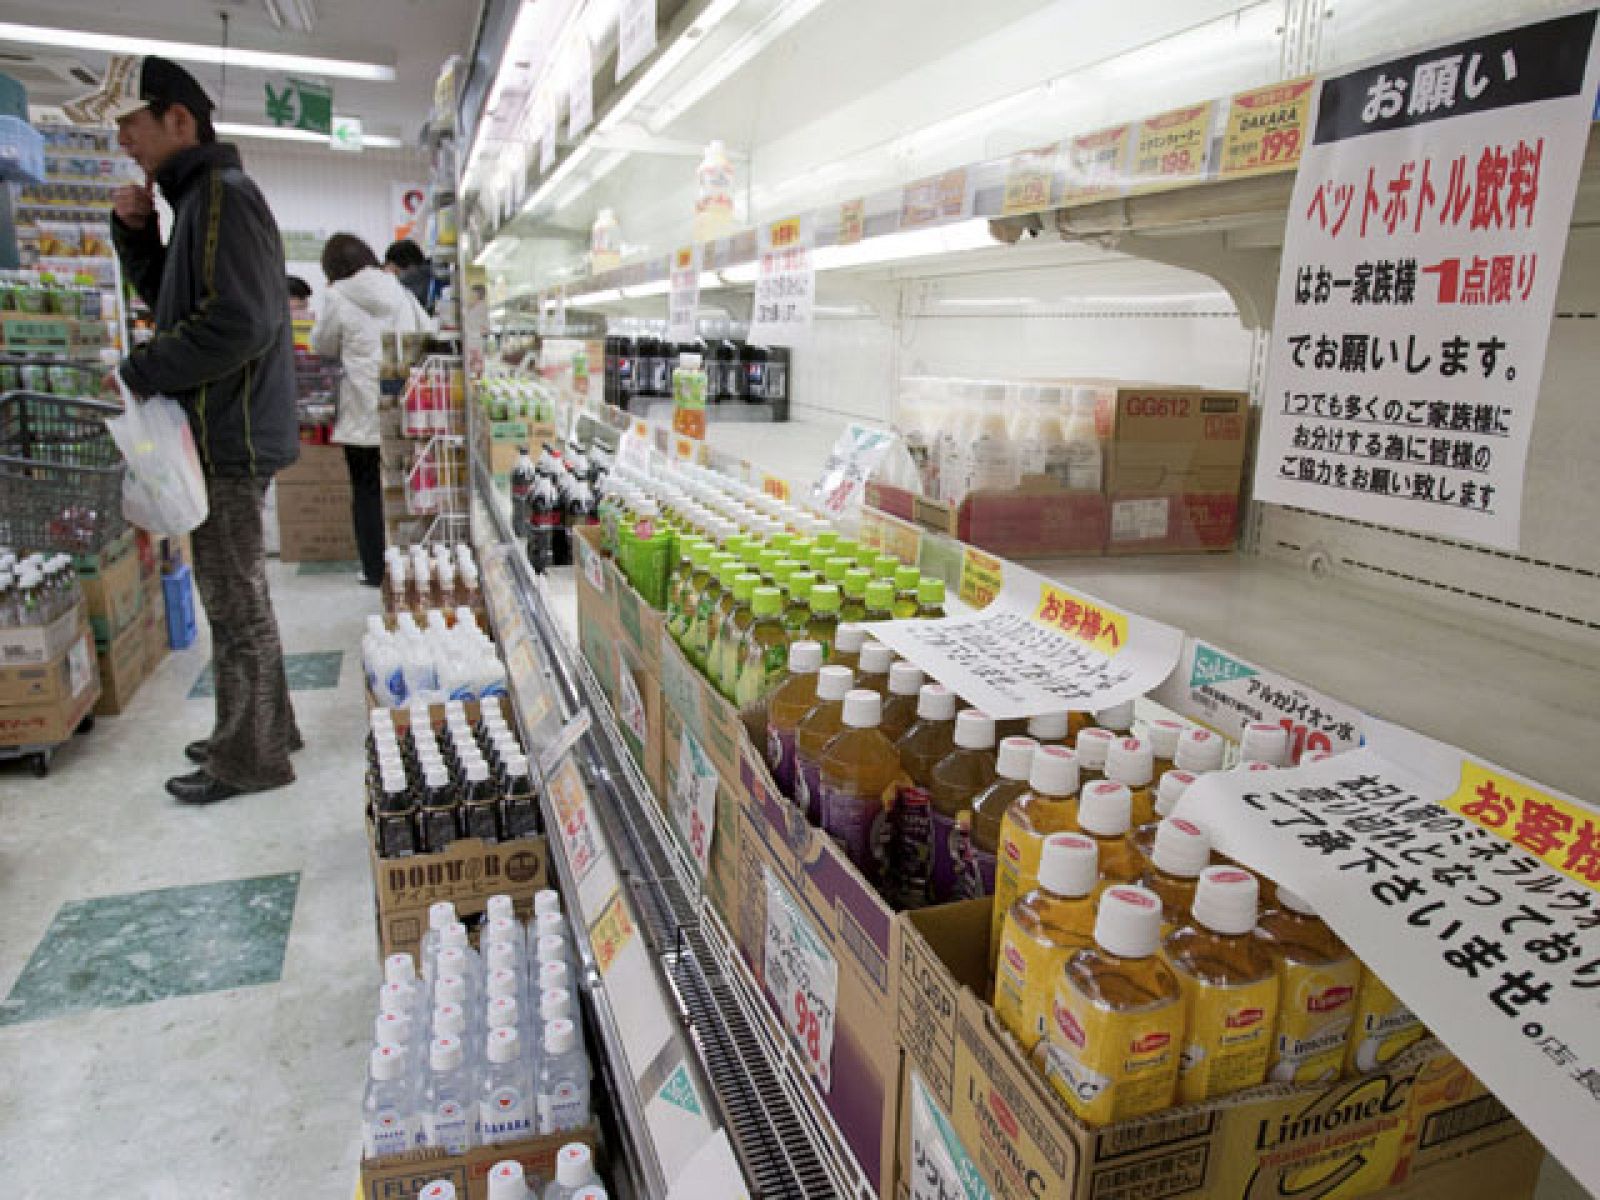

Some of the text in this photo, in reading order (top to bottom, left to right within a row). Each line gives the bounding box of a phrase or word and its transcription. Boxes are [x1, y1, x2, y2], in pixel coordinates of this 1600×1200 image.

[1362, 49, 1519, 123] お願い
[1307, 137, 1544, 238] ペットボトル飲料
[1287, 333, 1517, 381] でお願いします。
[1284, 391, 1513, 433] 1つでも多くのご家族様に
[1294, 424, 1492, 470] お分けする為に皆様の
[1279, 456, 1496, 511] ご協力をお願い致します
[1039, 591, 1121, 650] お客様へ
[1246, 679, 1355, 742] アルカリイオン水
